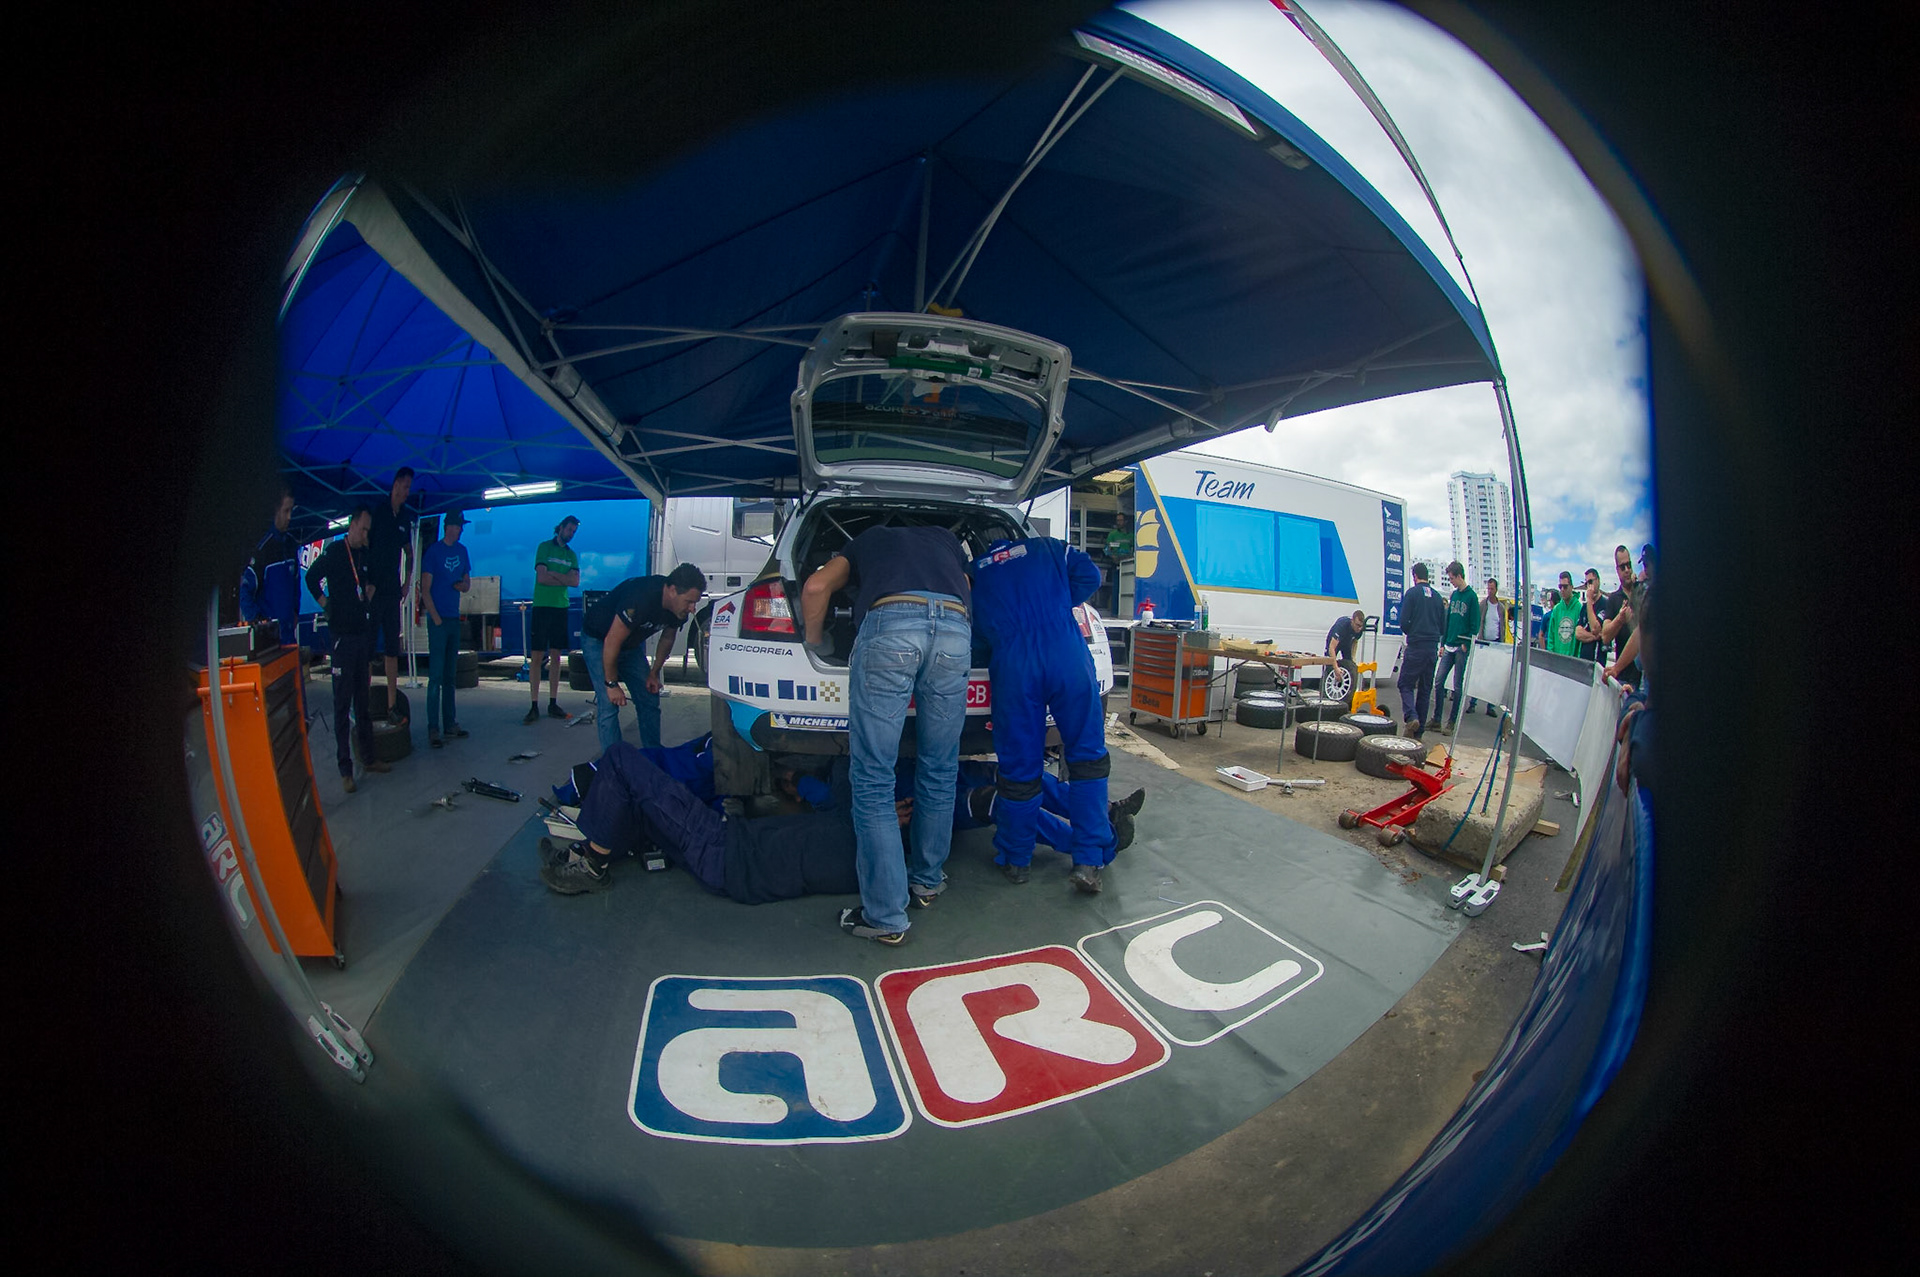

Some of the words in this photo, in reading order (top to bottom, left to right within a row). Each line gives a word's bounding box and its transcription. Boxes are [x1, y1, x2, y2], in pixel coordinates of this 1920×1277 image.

[1195, 470, 1256, 499] Team
[714, 615, 731, 624] ERA
[724, 643, 794, 657] SOCICORREIA
[789, 716, 849, 728] MICHELIN
